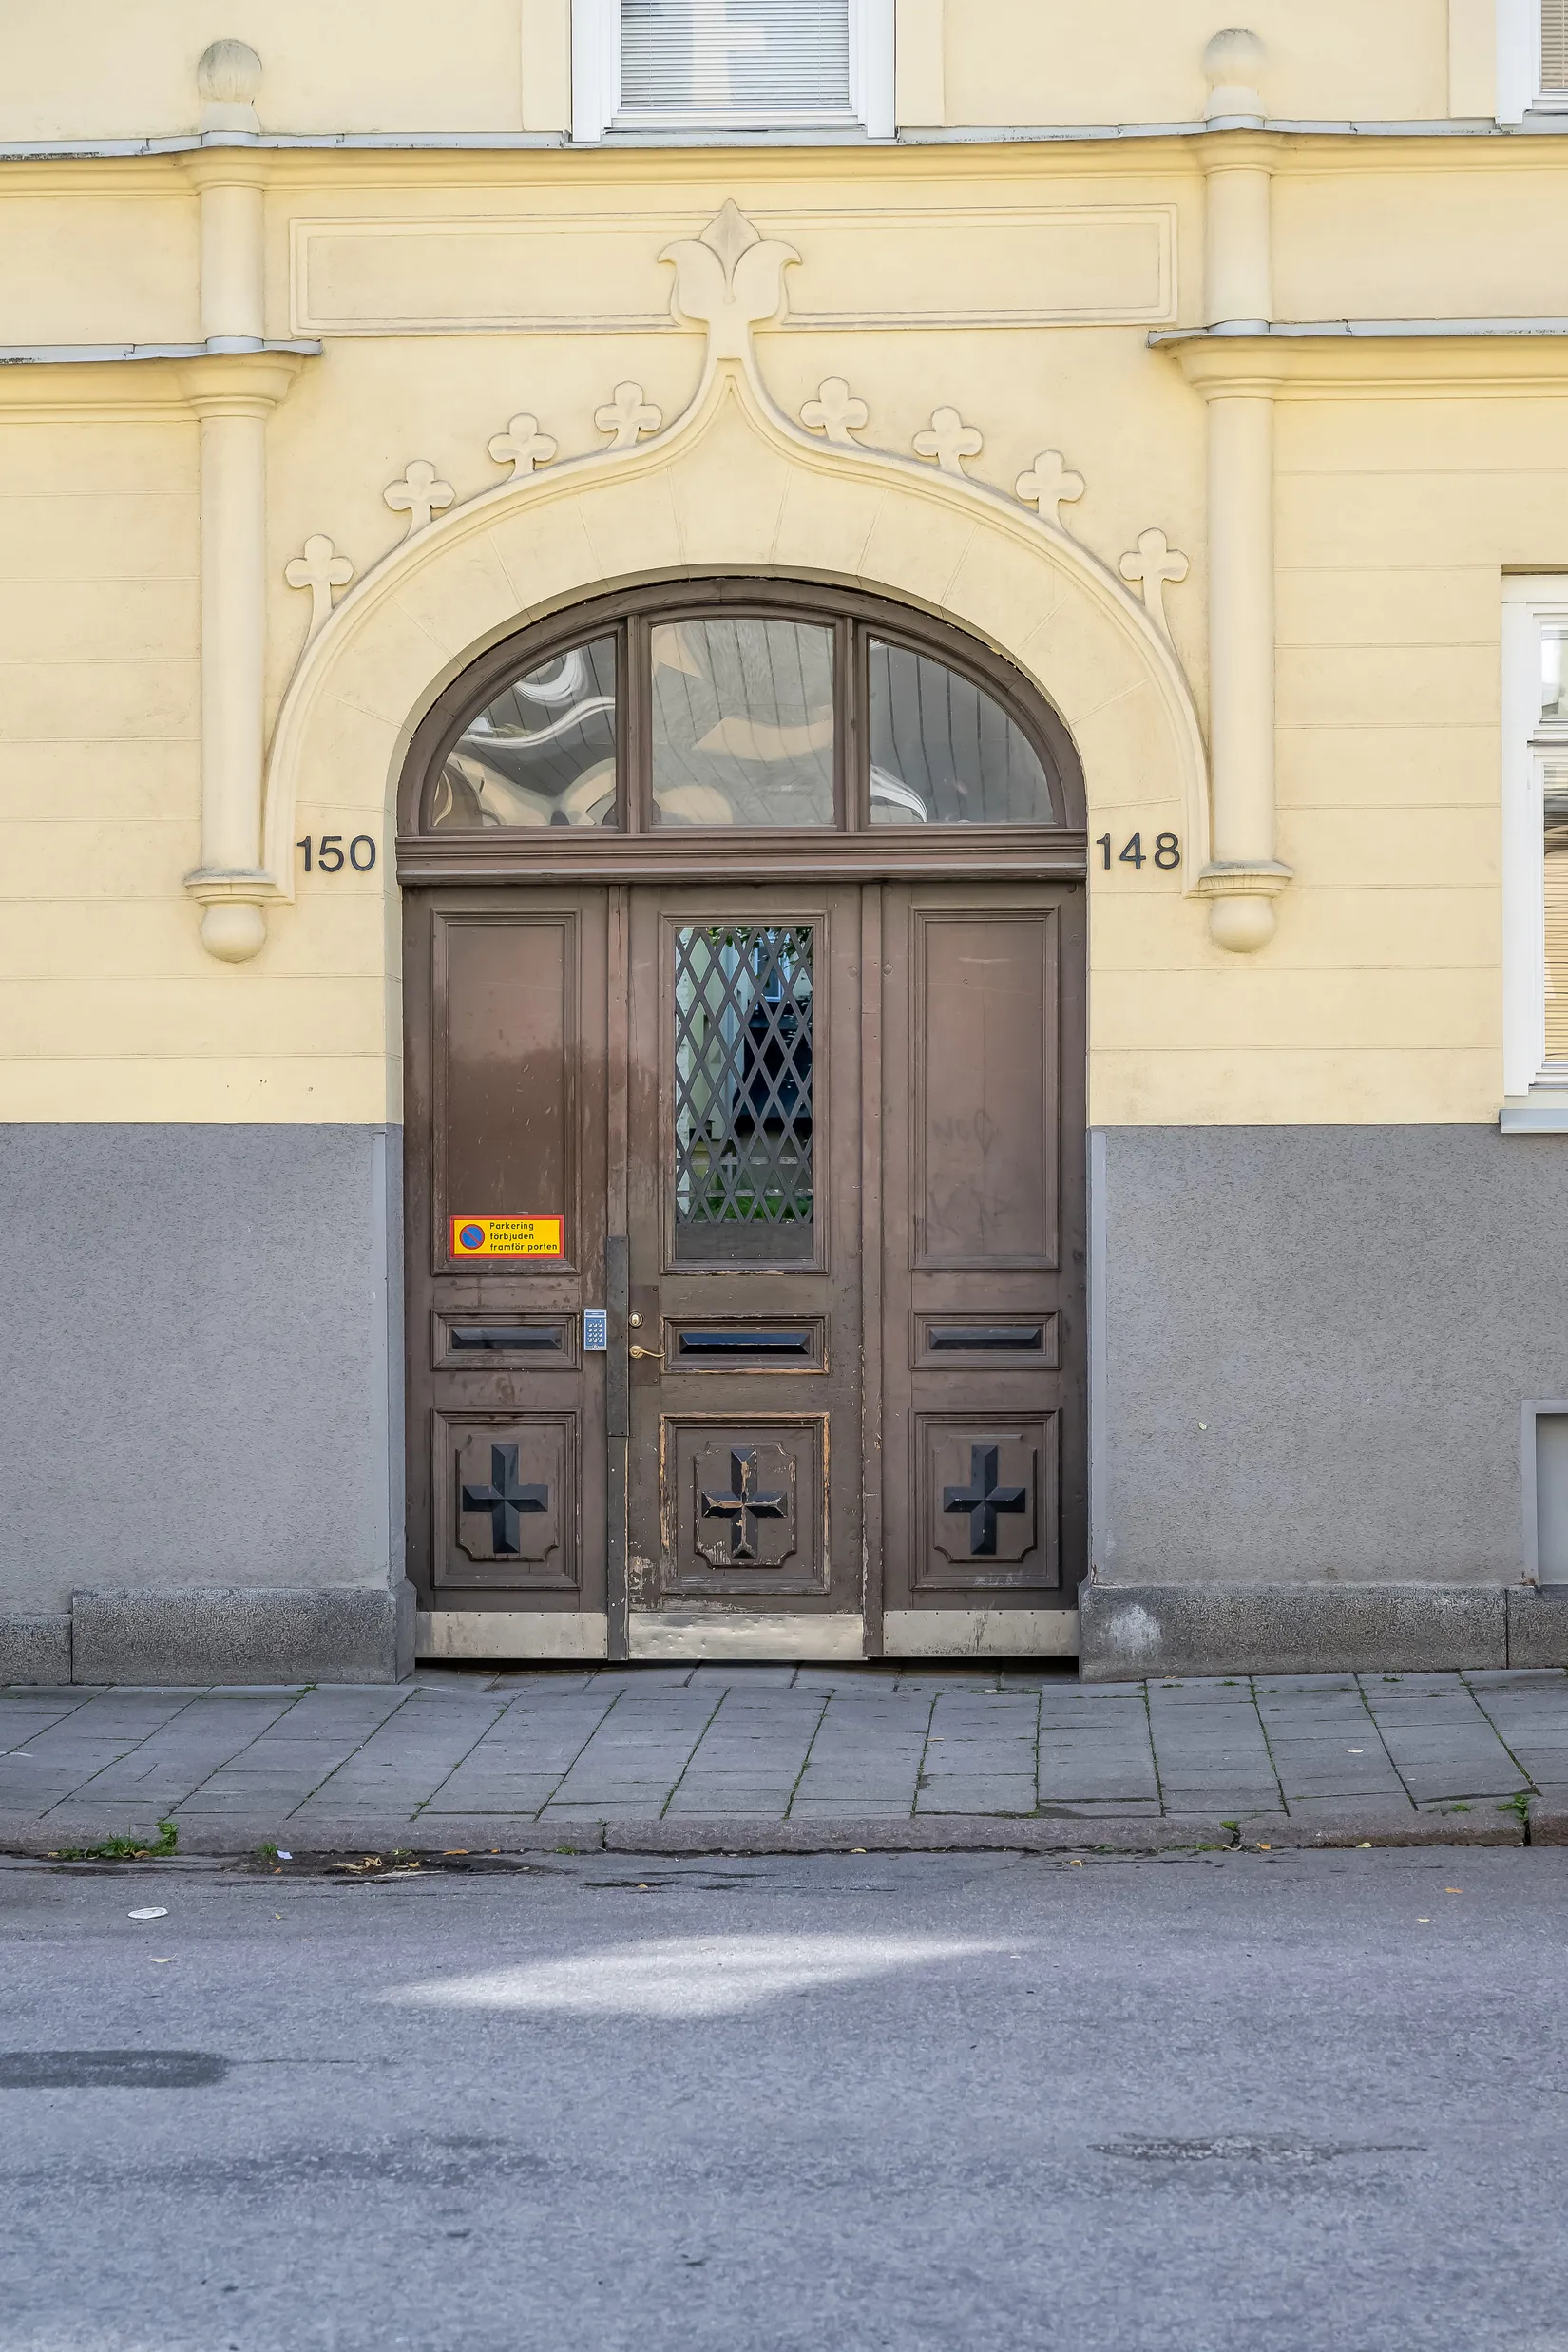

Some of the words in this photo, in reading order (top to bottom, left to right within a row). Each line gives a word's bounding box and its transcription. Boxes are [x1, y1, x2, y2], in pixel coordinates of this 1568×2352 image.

[296, 834, 376, 872] 150
[1096, 832, 1180, 870] 148
[489, 1222, 534, 1231] Parkering
[489, 1233, 534, 1241] förbjuden
[527, 1243, 558, 1252] porten
